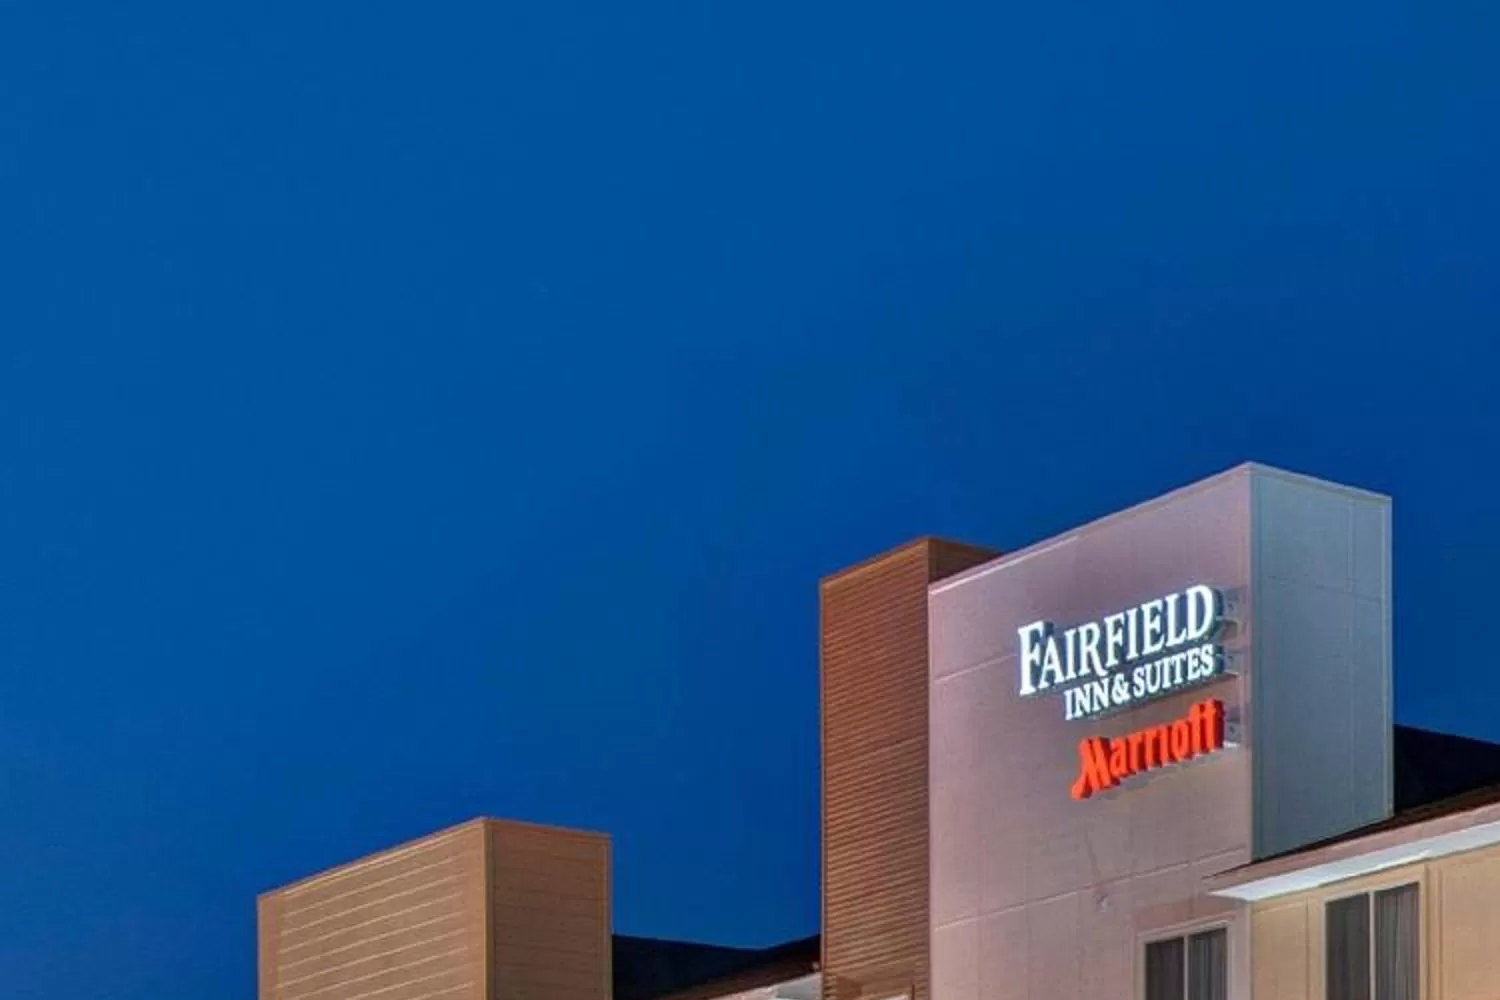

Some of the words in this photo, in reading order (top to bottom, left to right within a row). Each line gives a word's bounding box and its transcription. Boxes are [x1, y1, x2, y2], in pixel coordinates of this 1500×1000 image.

[1017, 584, 1217, 696] FAIRFIELD
[1132, 643, 1214, 699] SUITES
[1070, 697, 1220, 800] Marriott
